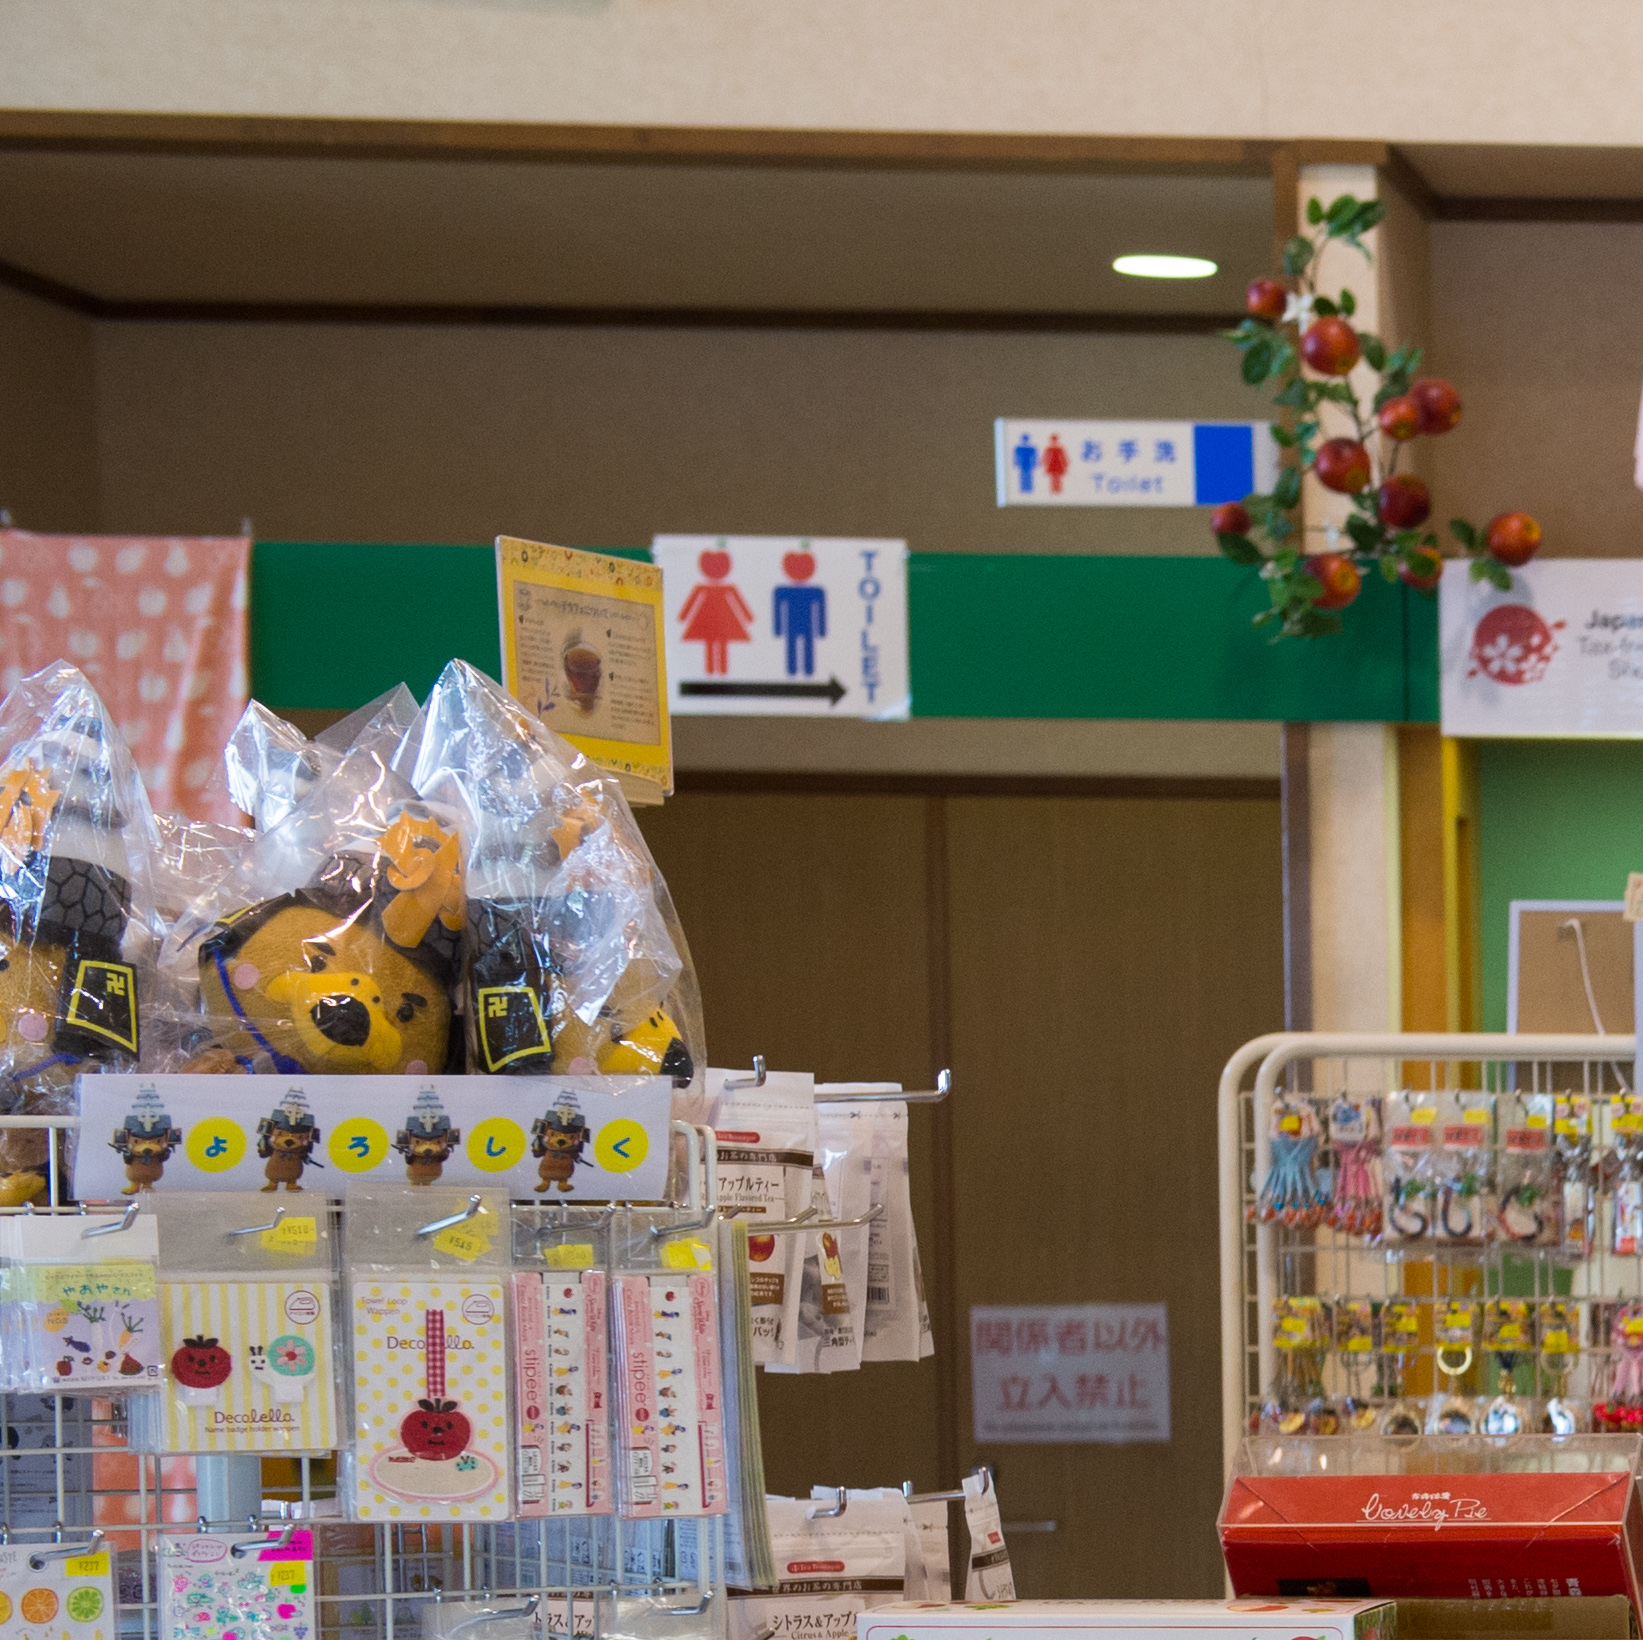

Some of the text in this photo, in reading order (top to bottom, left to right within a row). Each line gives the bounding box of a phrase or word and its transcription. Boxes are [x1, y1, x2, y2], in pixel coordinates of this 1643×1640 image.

[1080, 438, 1177, 465] お手洗
[1091, 473, 1164, 495] Toilet
[858, 550, 881, 704] TOILET
[974, 1315, 1166, 1357] 関係者以外
[999, 1371, 1152, 1412] 立入禁止
